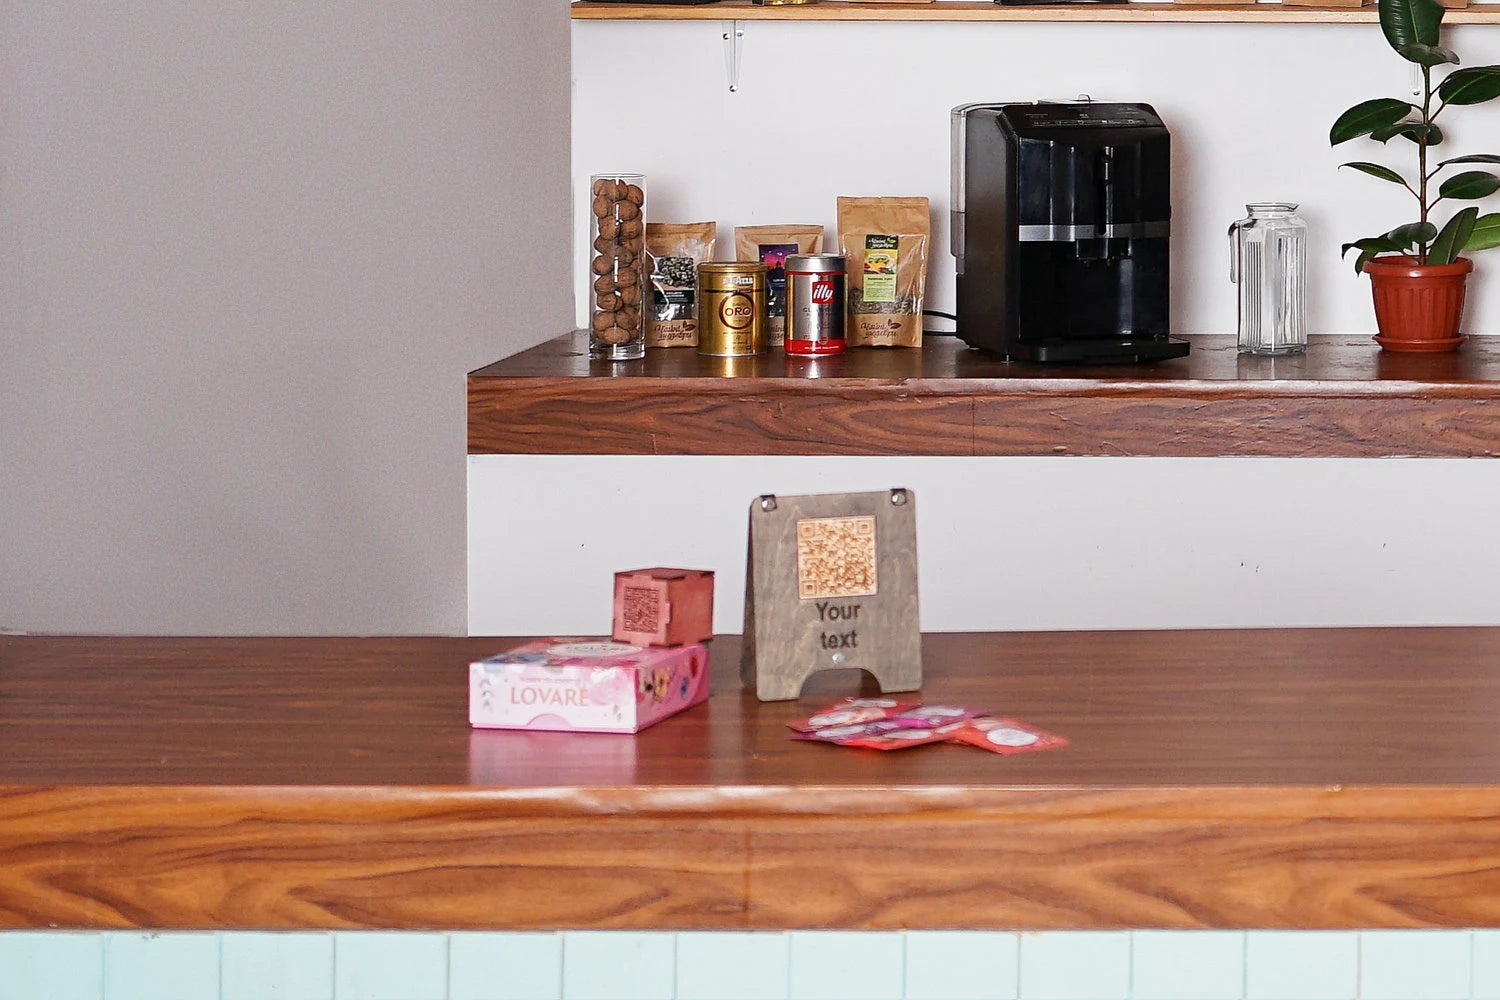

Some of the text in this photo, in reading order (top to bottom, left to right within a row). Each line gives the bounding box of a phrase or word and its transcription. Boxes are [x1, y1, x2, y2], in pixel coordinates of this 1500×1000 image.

[813, 285, 833, 302] illy
[725, 306, 751, 317] ORO
[816, 602, 861, 620] Your
[821, 629, 857, 650] text
[510, 685, 589, 707] LOVARE
